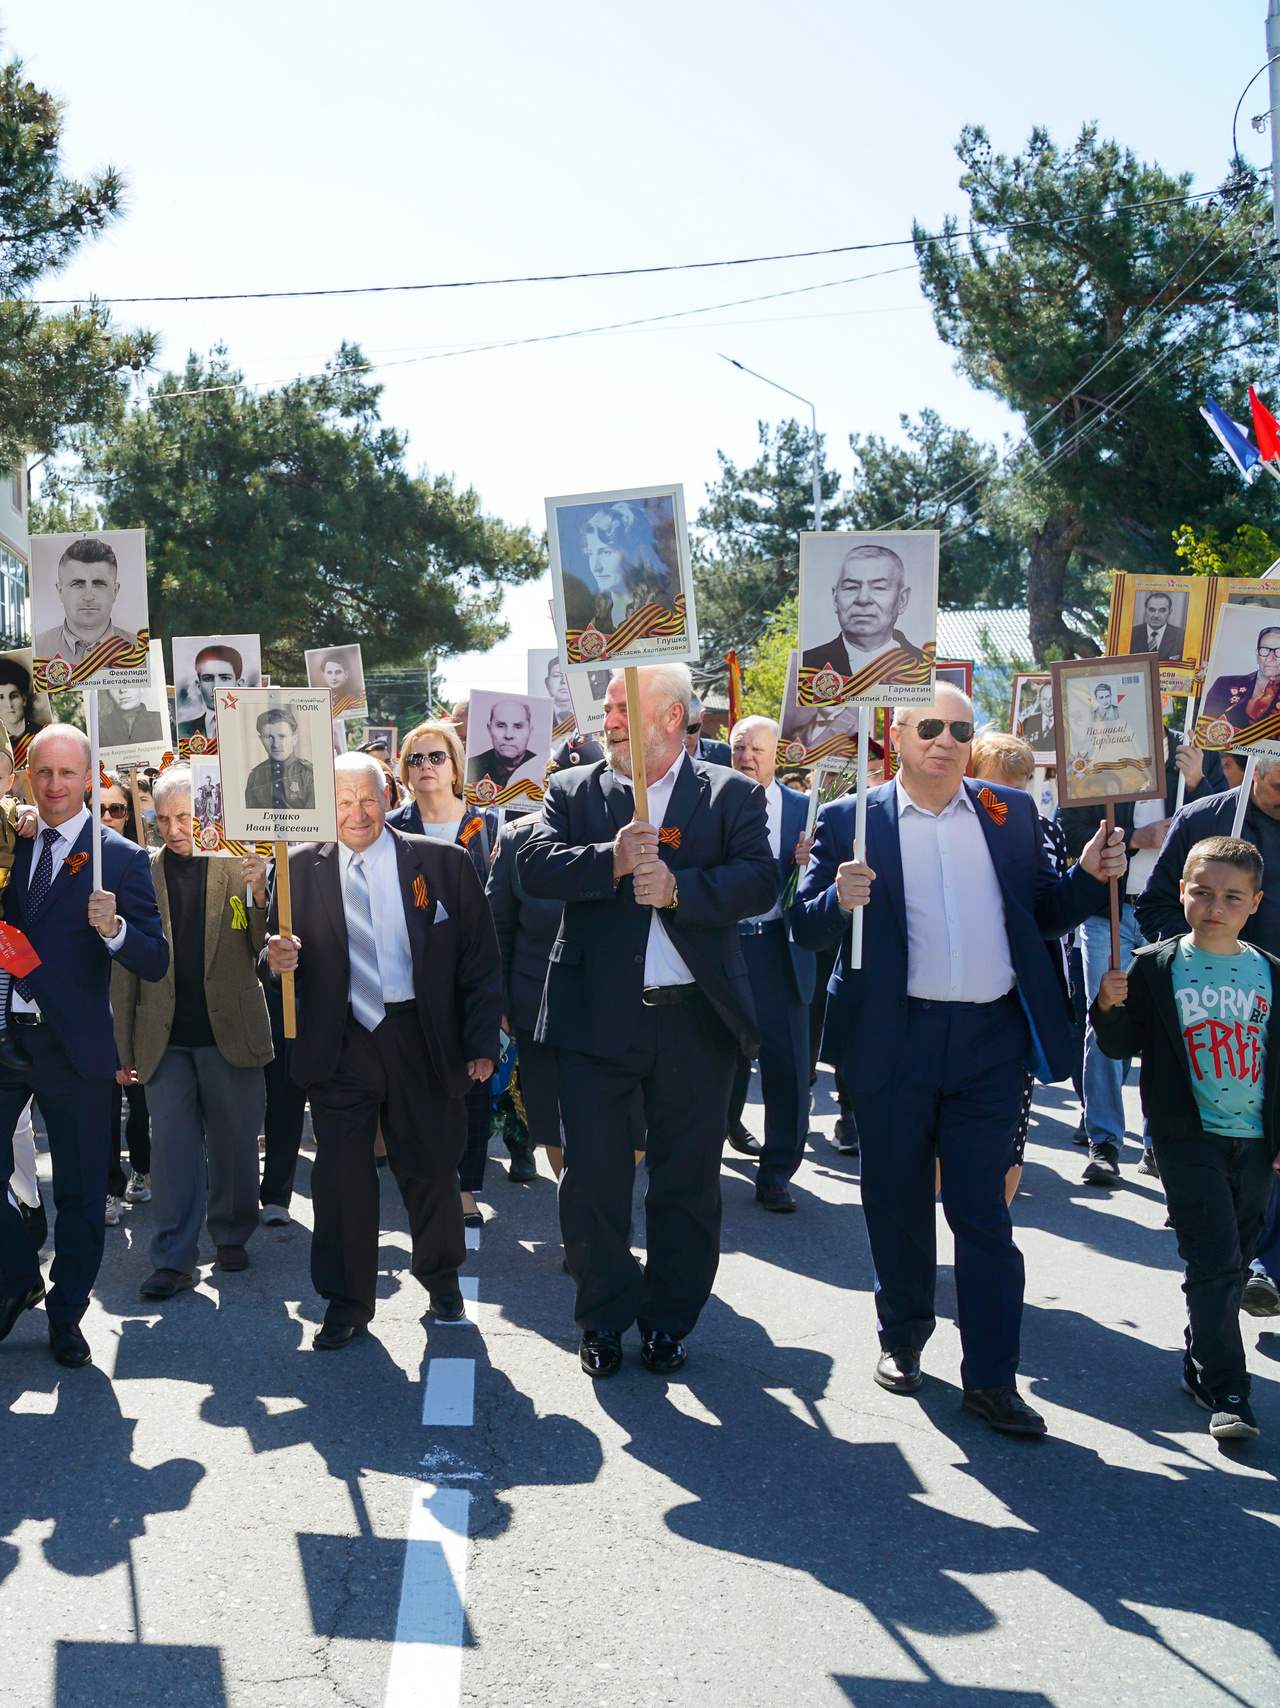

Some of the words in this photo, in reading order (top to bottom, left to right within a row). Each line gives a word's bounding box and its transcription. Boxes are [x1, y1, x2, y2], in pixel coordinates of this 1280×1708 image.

[656, 637, 688, 646] Глушко
[607, 649, 642, 658] Анастасия
[888, 685, 932, 694] Гарматин
[845, 694, 880, 702] Василий
[262, 811, 300, 822] Глушко
[245, 823, 272, 832] Иван
[273, 823, 320, 833] Евсеевич
[1175, 985, 1256, 1025] BORN
[1255, 995, 1268, 1013] TO
[1249, 1008, 1266, 1023] BE
[1183, 1019, 1262, 1084] FREE
